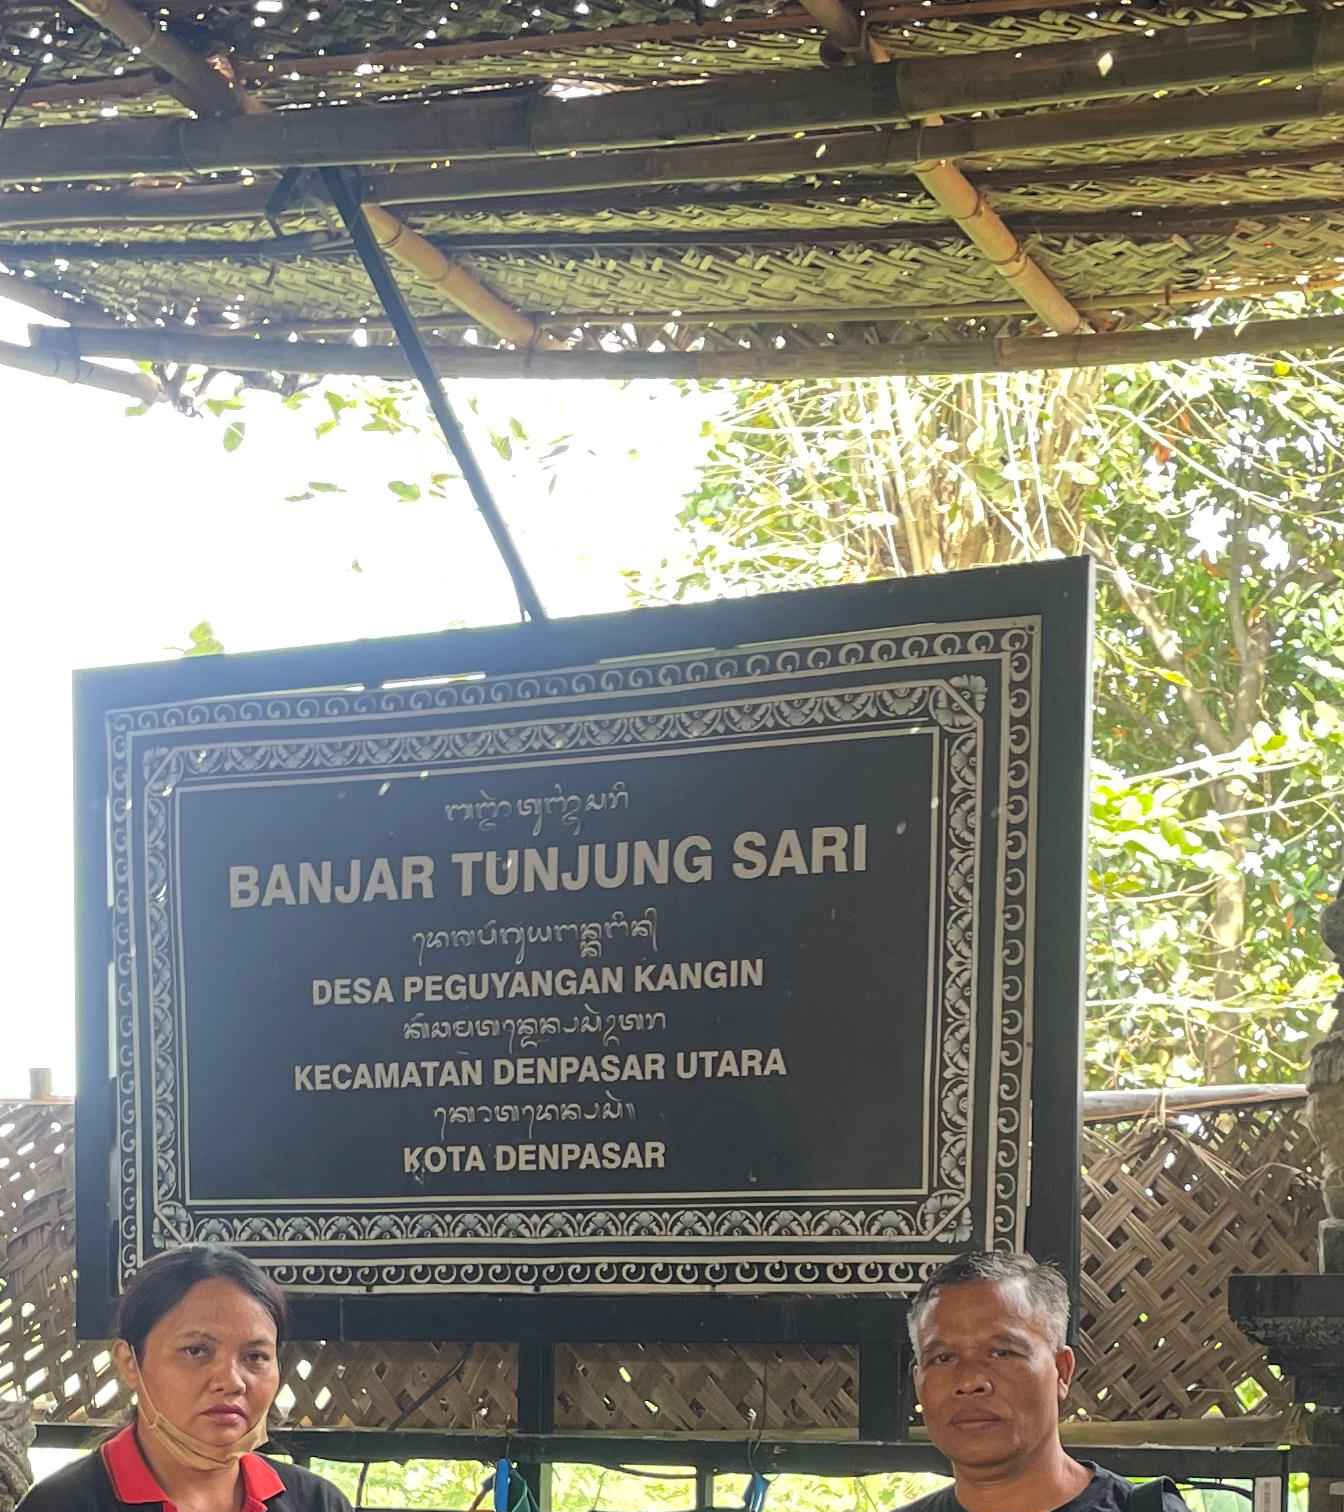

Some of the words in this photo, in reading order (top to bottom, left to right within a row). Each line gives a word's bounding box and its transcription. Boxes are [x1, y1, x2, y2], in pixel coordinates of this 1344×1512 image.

[229, 856, 435, 908] BANJAR
[452, 835, 712, 897] TUNJUNG
[732, 825, 867, 879] SARI
[312, 977, 394, 1005] DESA
[404, 965, 623, 1002] PEGUYANGAN
[635, 958, 763, 992] KANGIN
[294, 1060, 483, 1091] KECAMATAN
[493, 1052, 666, 1087] DENPASAR
[675, 1047, 787, 1080] UTARA
[403, 1145, 486, 1175] KOTA
[494, 1140, 666, 1172] DENPASAR
